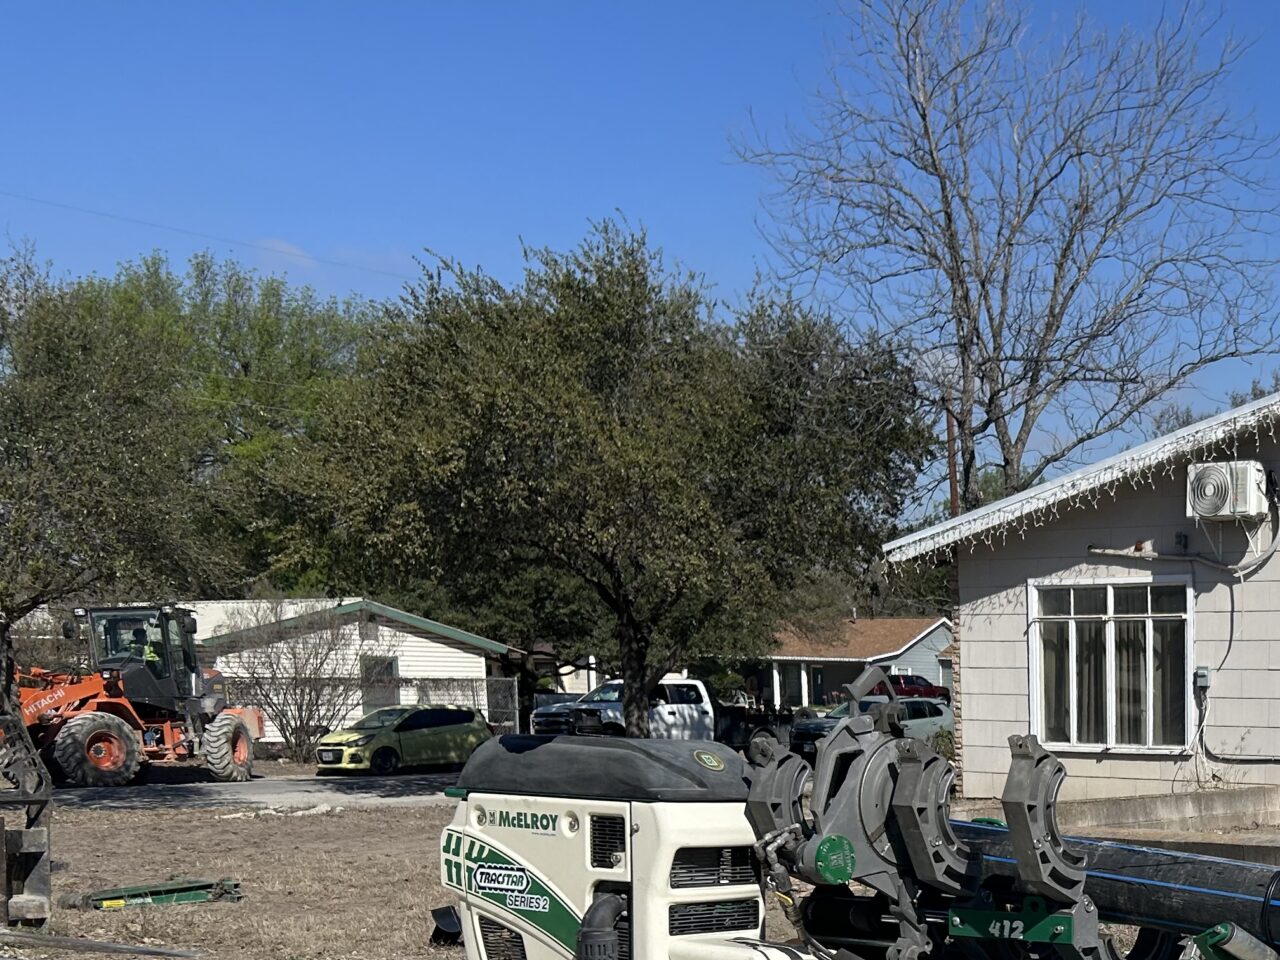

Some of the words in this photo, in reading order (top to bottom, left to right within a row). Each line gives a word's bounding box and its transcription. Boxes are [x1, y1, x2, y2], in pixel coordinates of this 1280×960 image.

[24, 689, 65, 715] HITACHI
[498, 811, 559, 831] McELROY
[479, 871, 525, 887] TRACSTAR
[508, 895, 541, 909] SERIES
[542, 898, 549, 910] 2
[989, 920, 1024, 939] 412
